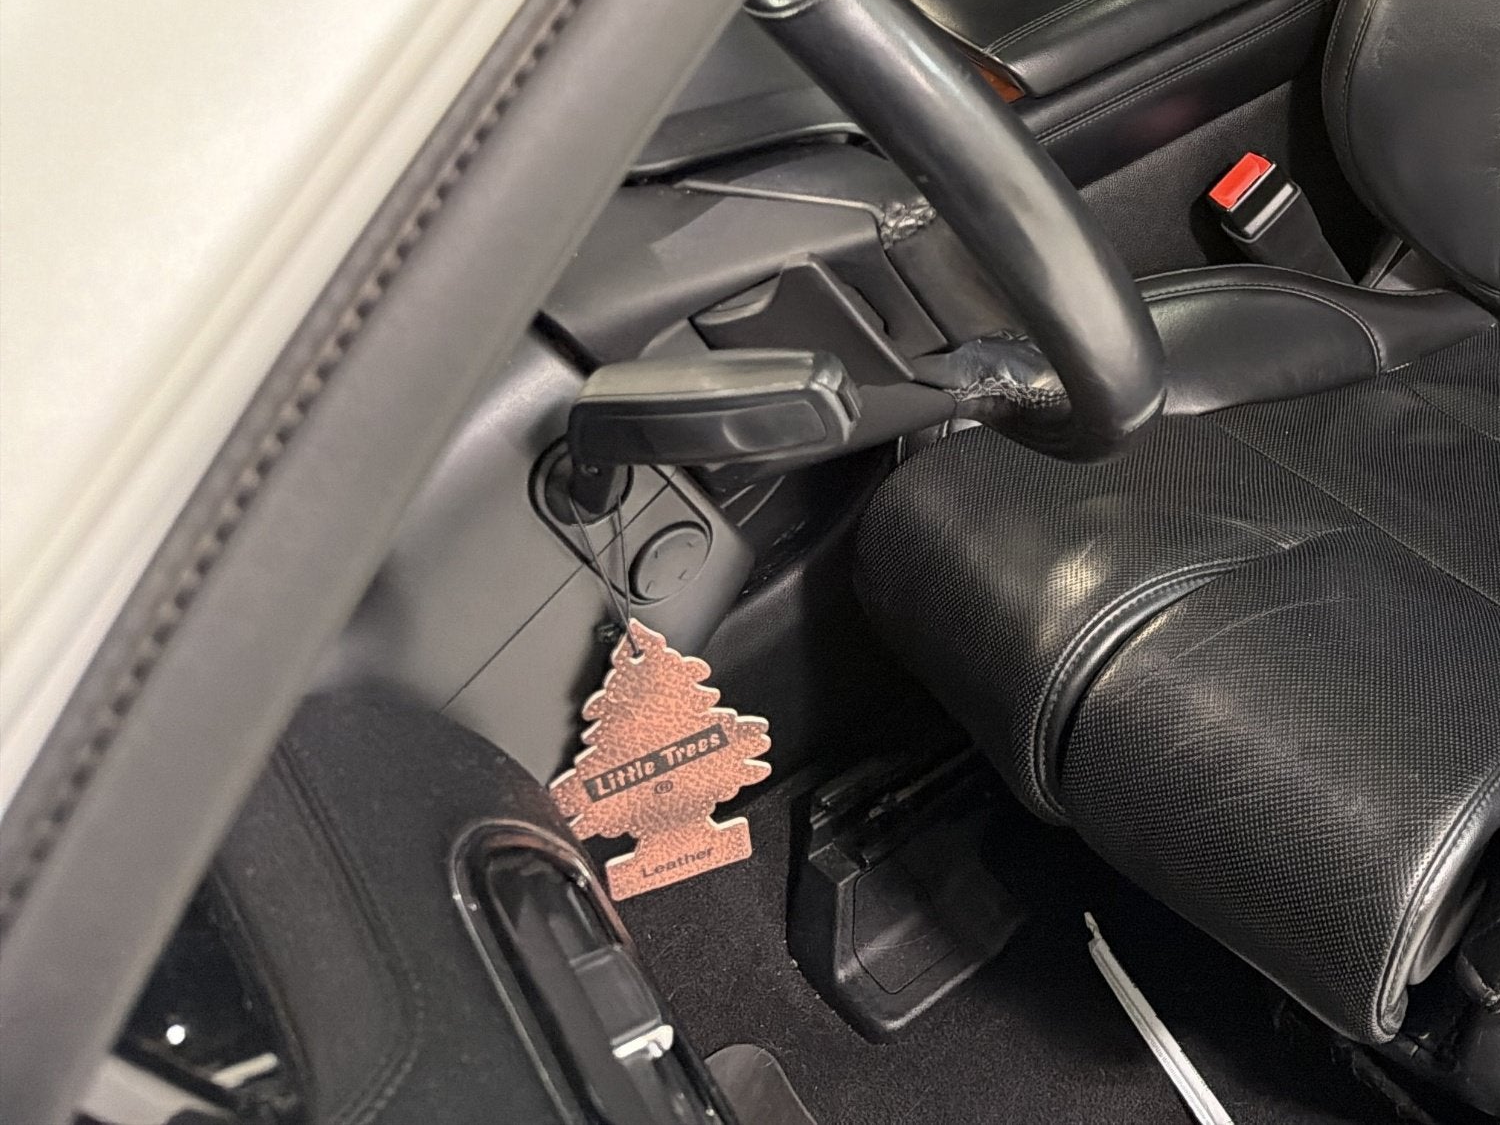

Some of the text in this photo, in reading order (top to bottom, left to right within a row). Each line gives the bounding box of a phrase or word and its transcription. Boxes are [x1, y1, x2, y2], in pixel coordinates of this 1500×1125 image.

[594, 732, 722, 797] Little Trees
[639, 845, 715, 878] Leather
